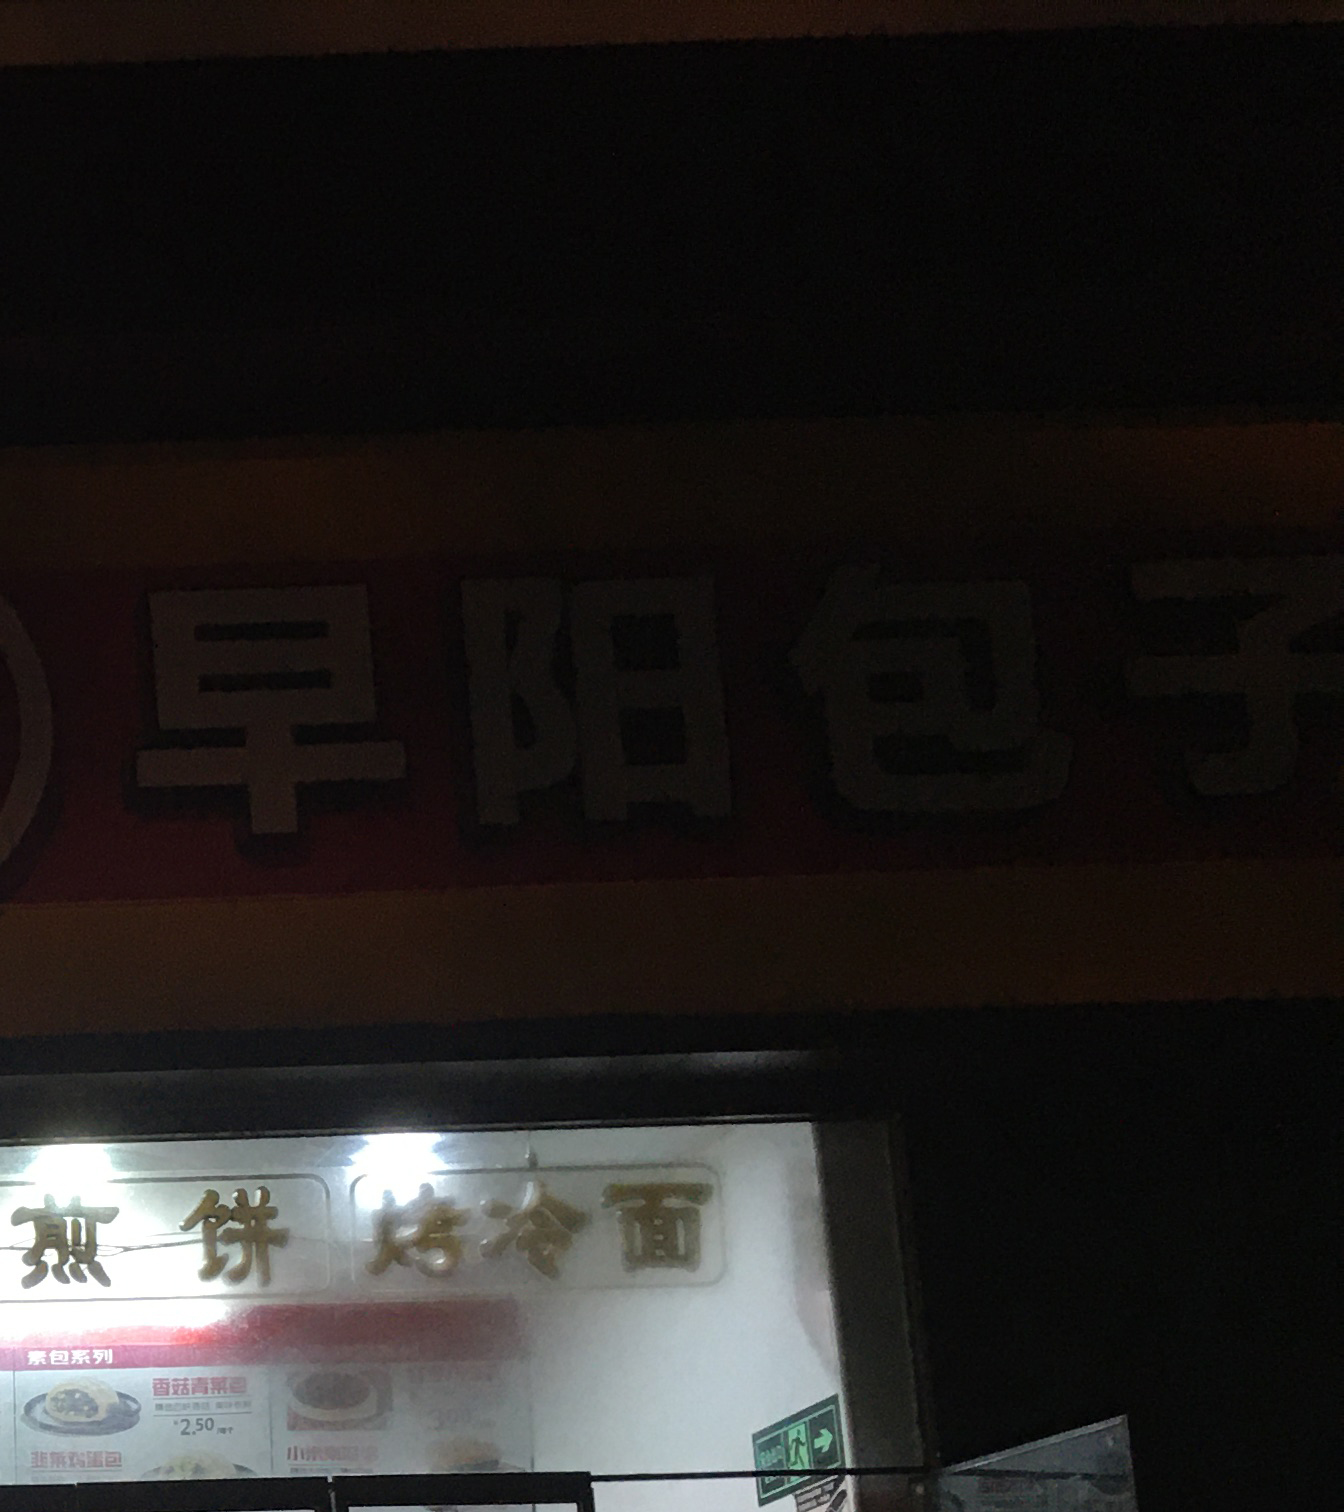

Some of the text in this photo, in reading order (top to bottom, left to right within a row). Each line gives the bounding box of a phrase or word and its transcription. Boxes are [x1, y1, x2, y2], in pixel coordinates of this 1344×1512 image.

[11, 1186, 290, 1290] 煎饼
[362, 1182, 714, 1280] 烤冷面
[27, 1348, 114, 1364] 素包系列
[152, 1377, 247, 1396] 香菇青菜包
